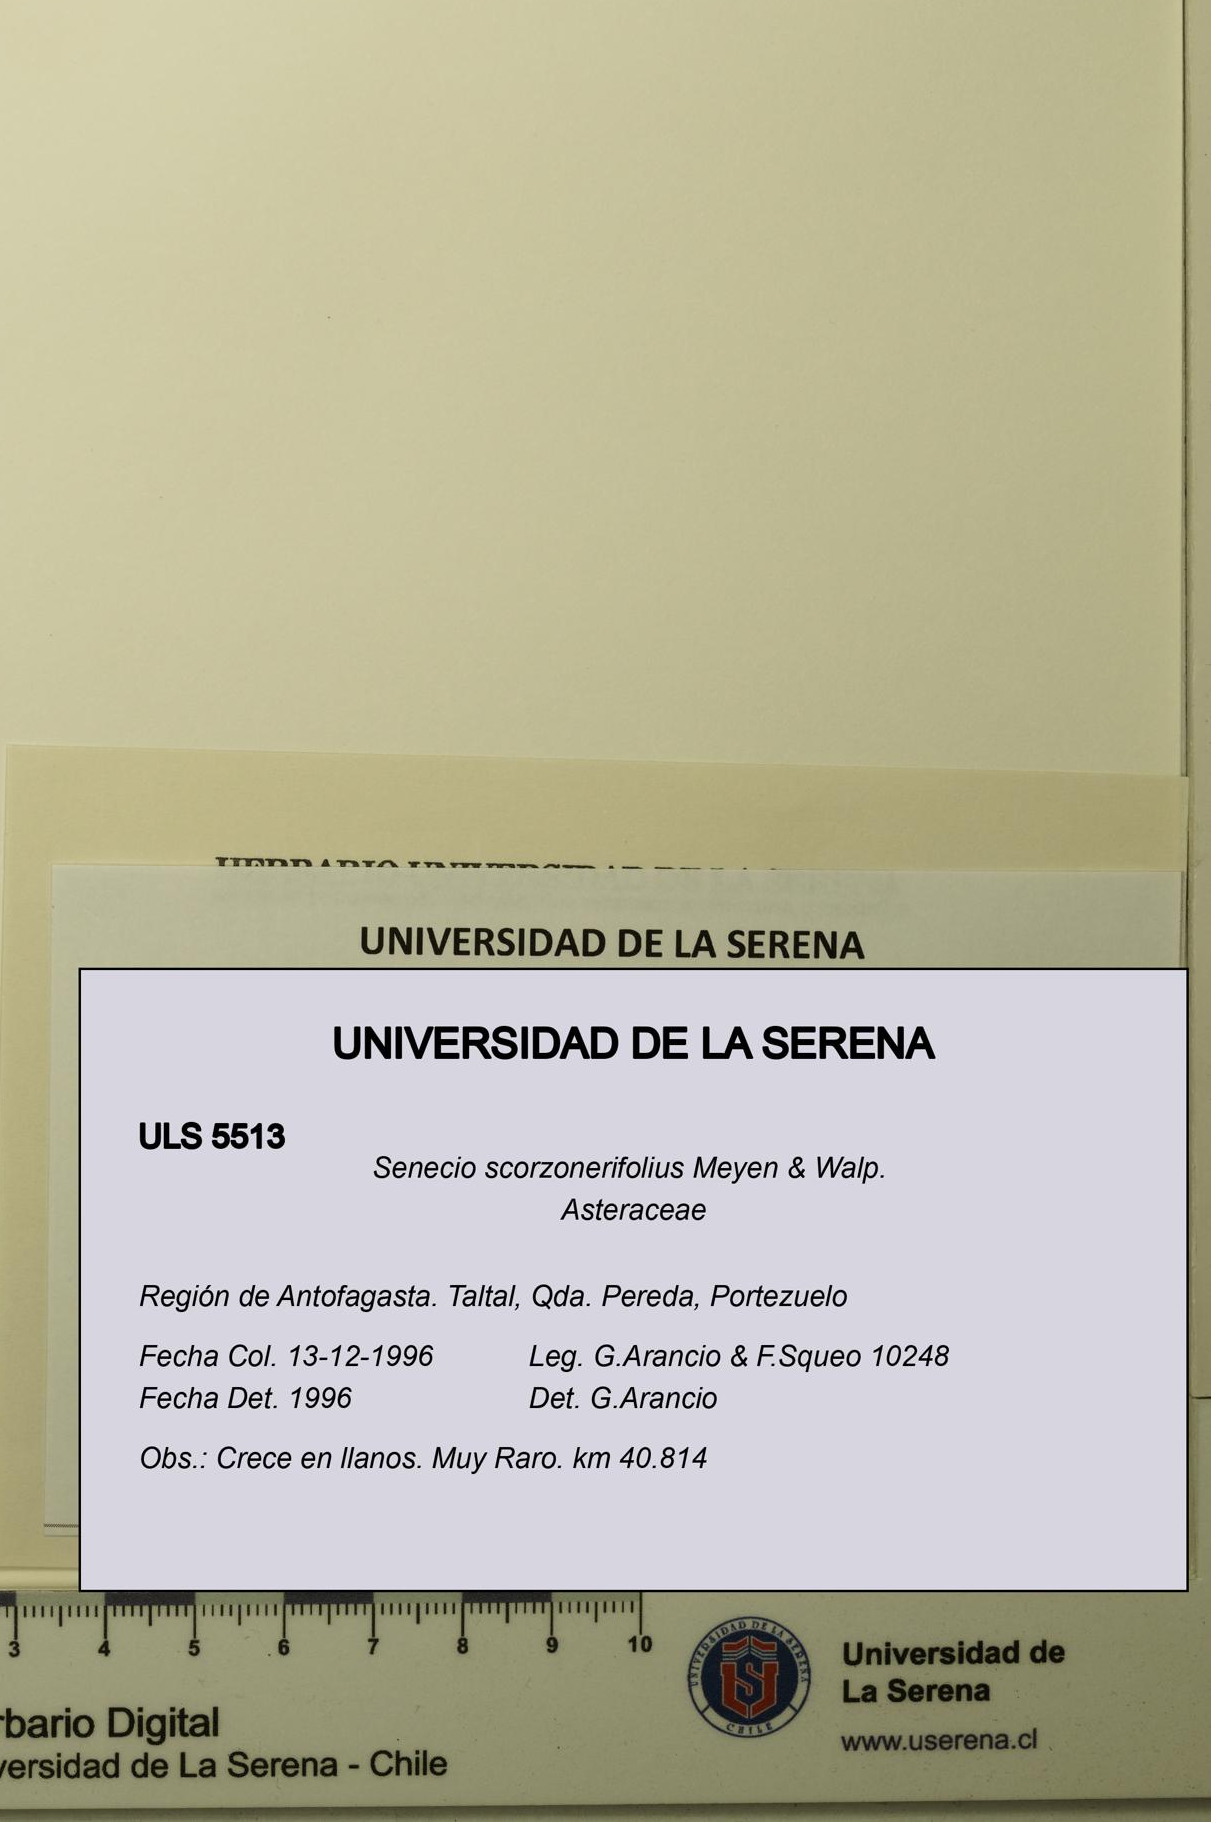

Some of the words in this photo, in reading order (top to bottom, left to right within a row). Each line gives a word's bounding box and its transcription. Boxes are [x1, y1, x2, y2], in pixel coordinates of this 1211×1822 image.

[361, 926, 606, 958] UNIVERSIDAD
[618, 928, 663, 958] DE
[675, 929, 717, 959] LA
[727, 929, 866, 960] SERENA
[8, 1639, 21, 1658] 3
[97, 1639, 111, 1658] 4
[188, 1639, 201, 1658] 5
[277, 1639, 291, 1658] 6
[367, 1639, 380, 1657] 7
[456, 1639, 469, 1656] 8
[545, 1638, 559, 1656] 9
[627, 1638, 653, 1655] 10
[843, 1639, 1020, 1667] Universidad
[1029, 1639, 1066, 1664] de
[842, 1679, 878, 1704] La
[886, 1677, 991, 1703] Serena
[108, 1706, 219, 1746] Digital
[840, 1727, 1038, 1752] www.userena.cl
[130, 1751, 169, 1780] de
[179, 1751, 217, 1779] La
[227, 1750, 338, 1779] Serena
[370, 1749, 448, 1777] Chile
